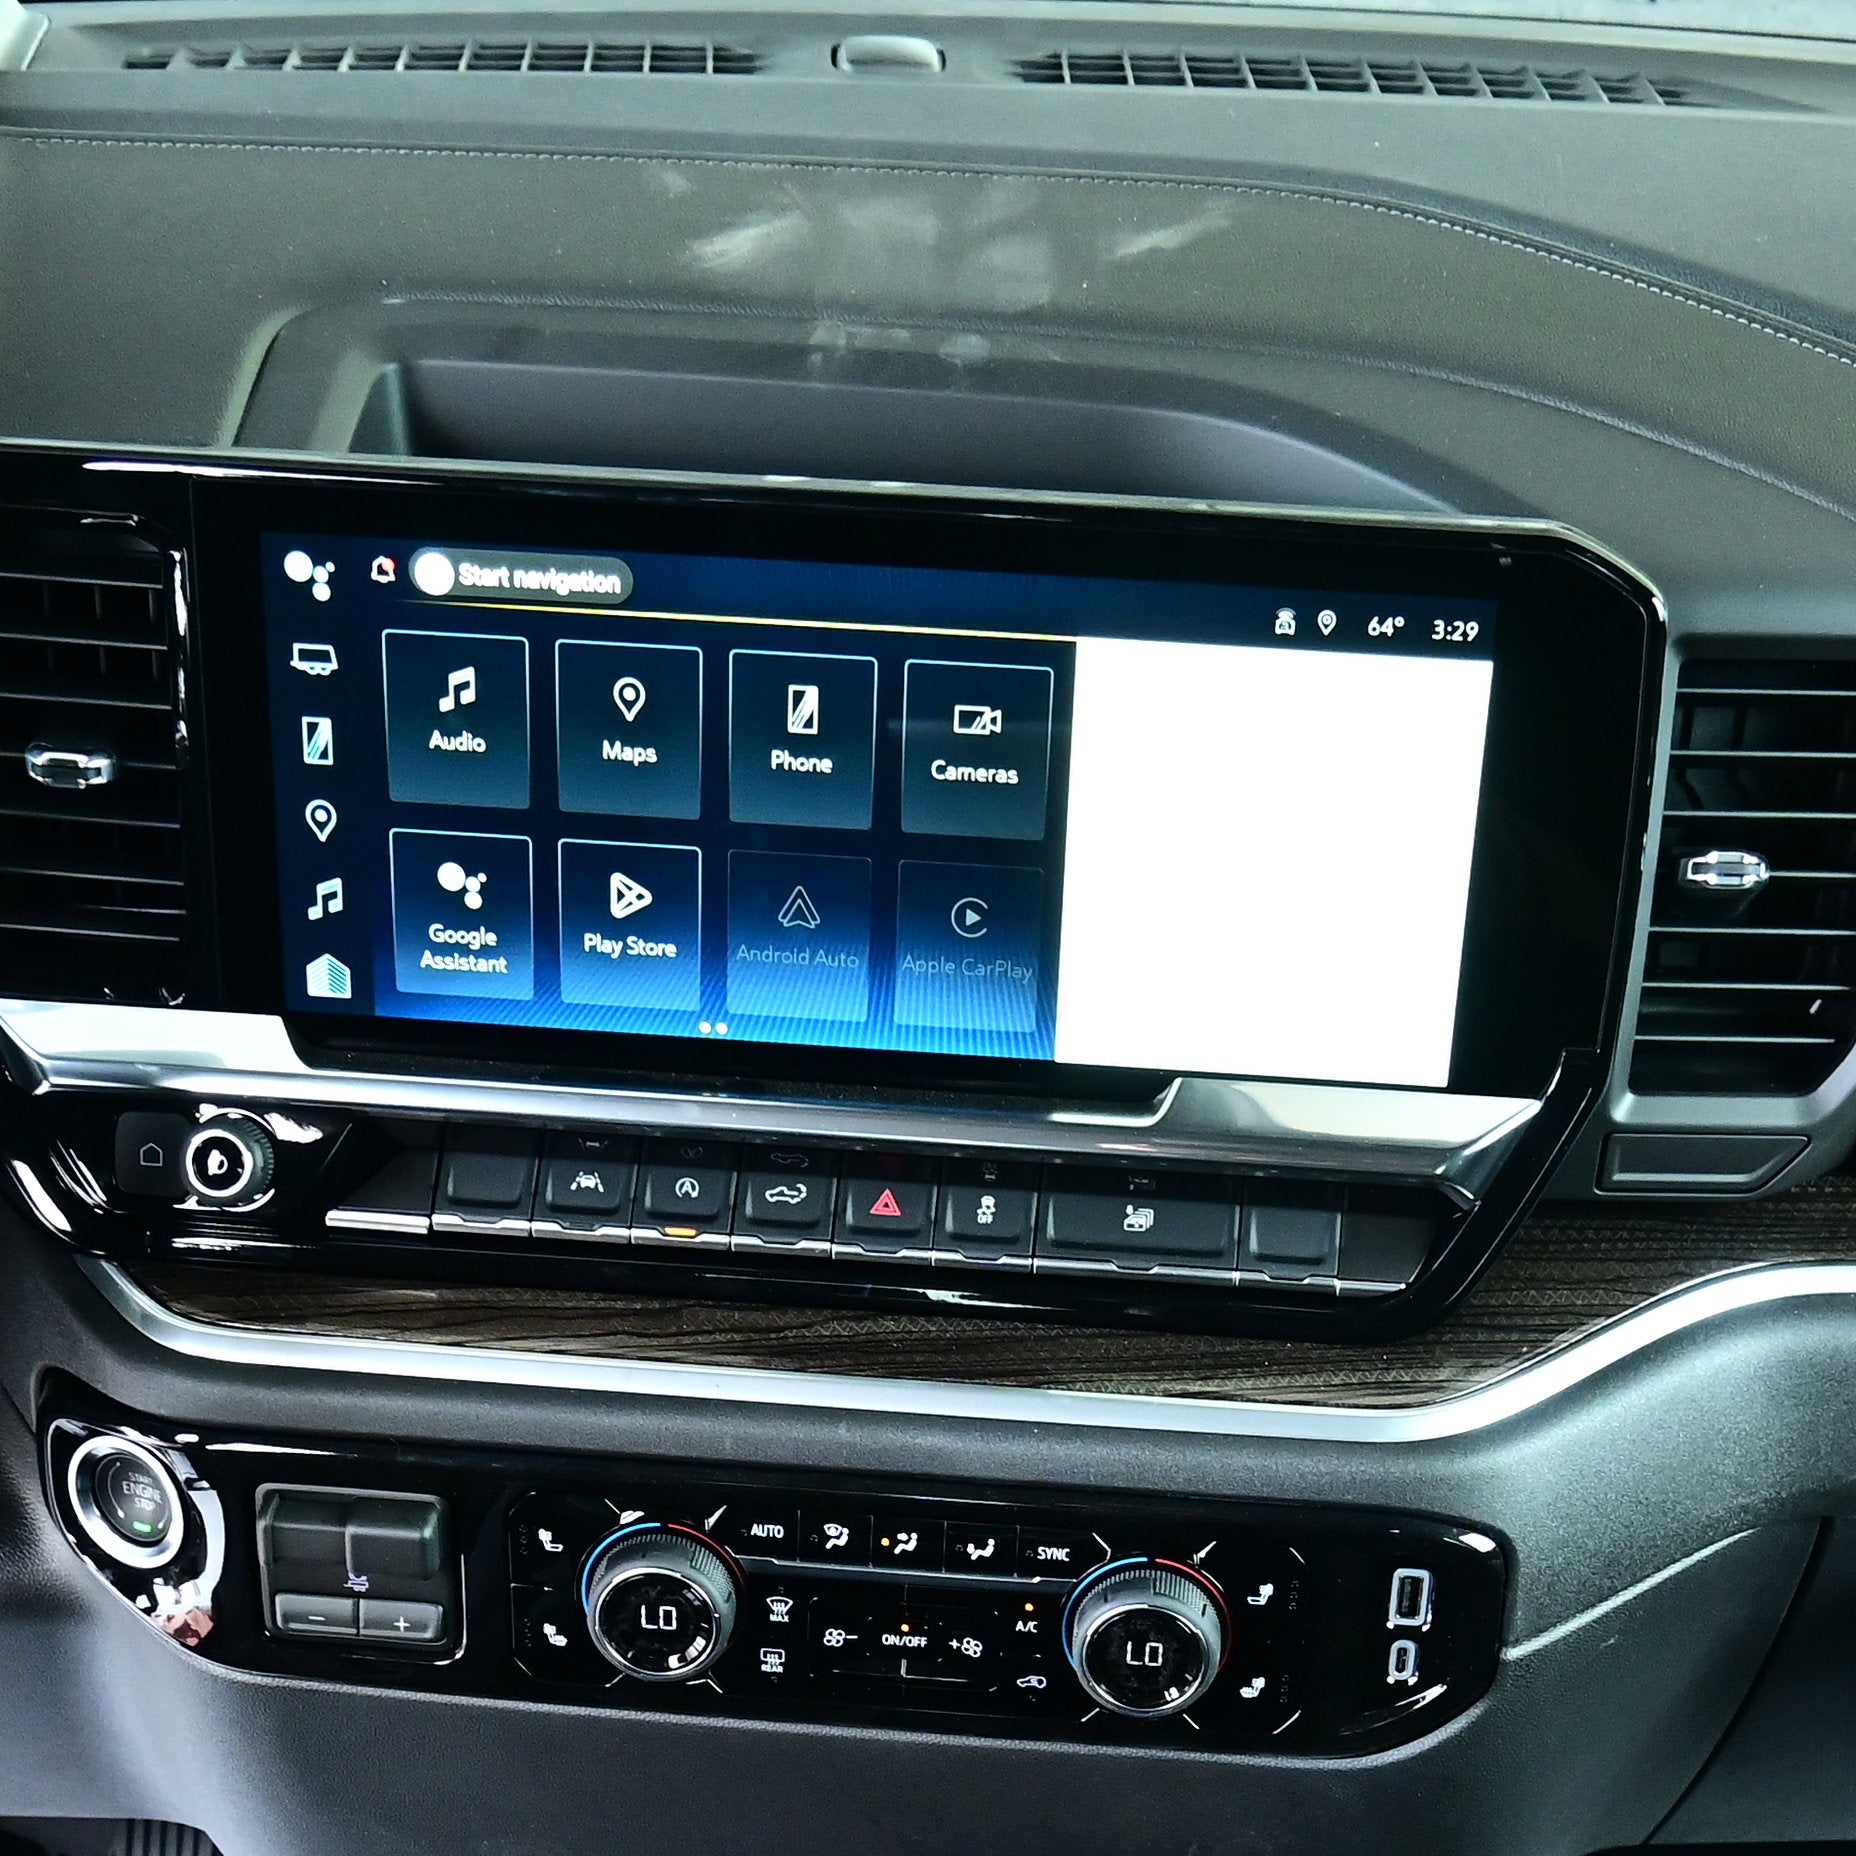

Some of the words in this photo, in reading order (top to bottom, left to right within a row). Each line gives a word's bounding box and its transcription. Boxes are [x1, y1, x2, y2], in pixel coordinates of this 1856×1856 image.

[458, 562, 510, 590] Start
[514, 568, 622, 595] navigation
[1431, 619, 1479, 642] 3:29
[429, 730, 486, 754] Audio
[602, 740, 657, 766] Maps
[771, 750, 833, 774] Phone
[931, 760, 1019, 785] Cameras
[428, 923, 498, 950] Google
[584, 933, 622, 958] Play
[626, 936, 677, 959] Store
[420, 951, 508, 975] Assistant
[736, 945, 809, 967] Android
[815, 949, 860, 969] Auto
[902, 955, 955, 978] Apple
[962, 958, 1033, 984] CarPlay
[122, 1481, 163, 1504] ENGINE
[134, 1497, 156, 1511] STOP
[750, 1523, 784, 1538] AUTO
[1037, 1547, 1071, 1562] SYNC
[1016, 1621, 1038, 1634] A/C
[882, 1634, 928, 1648] ON/OFF
